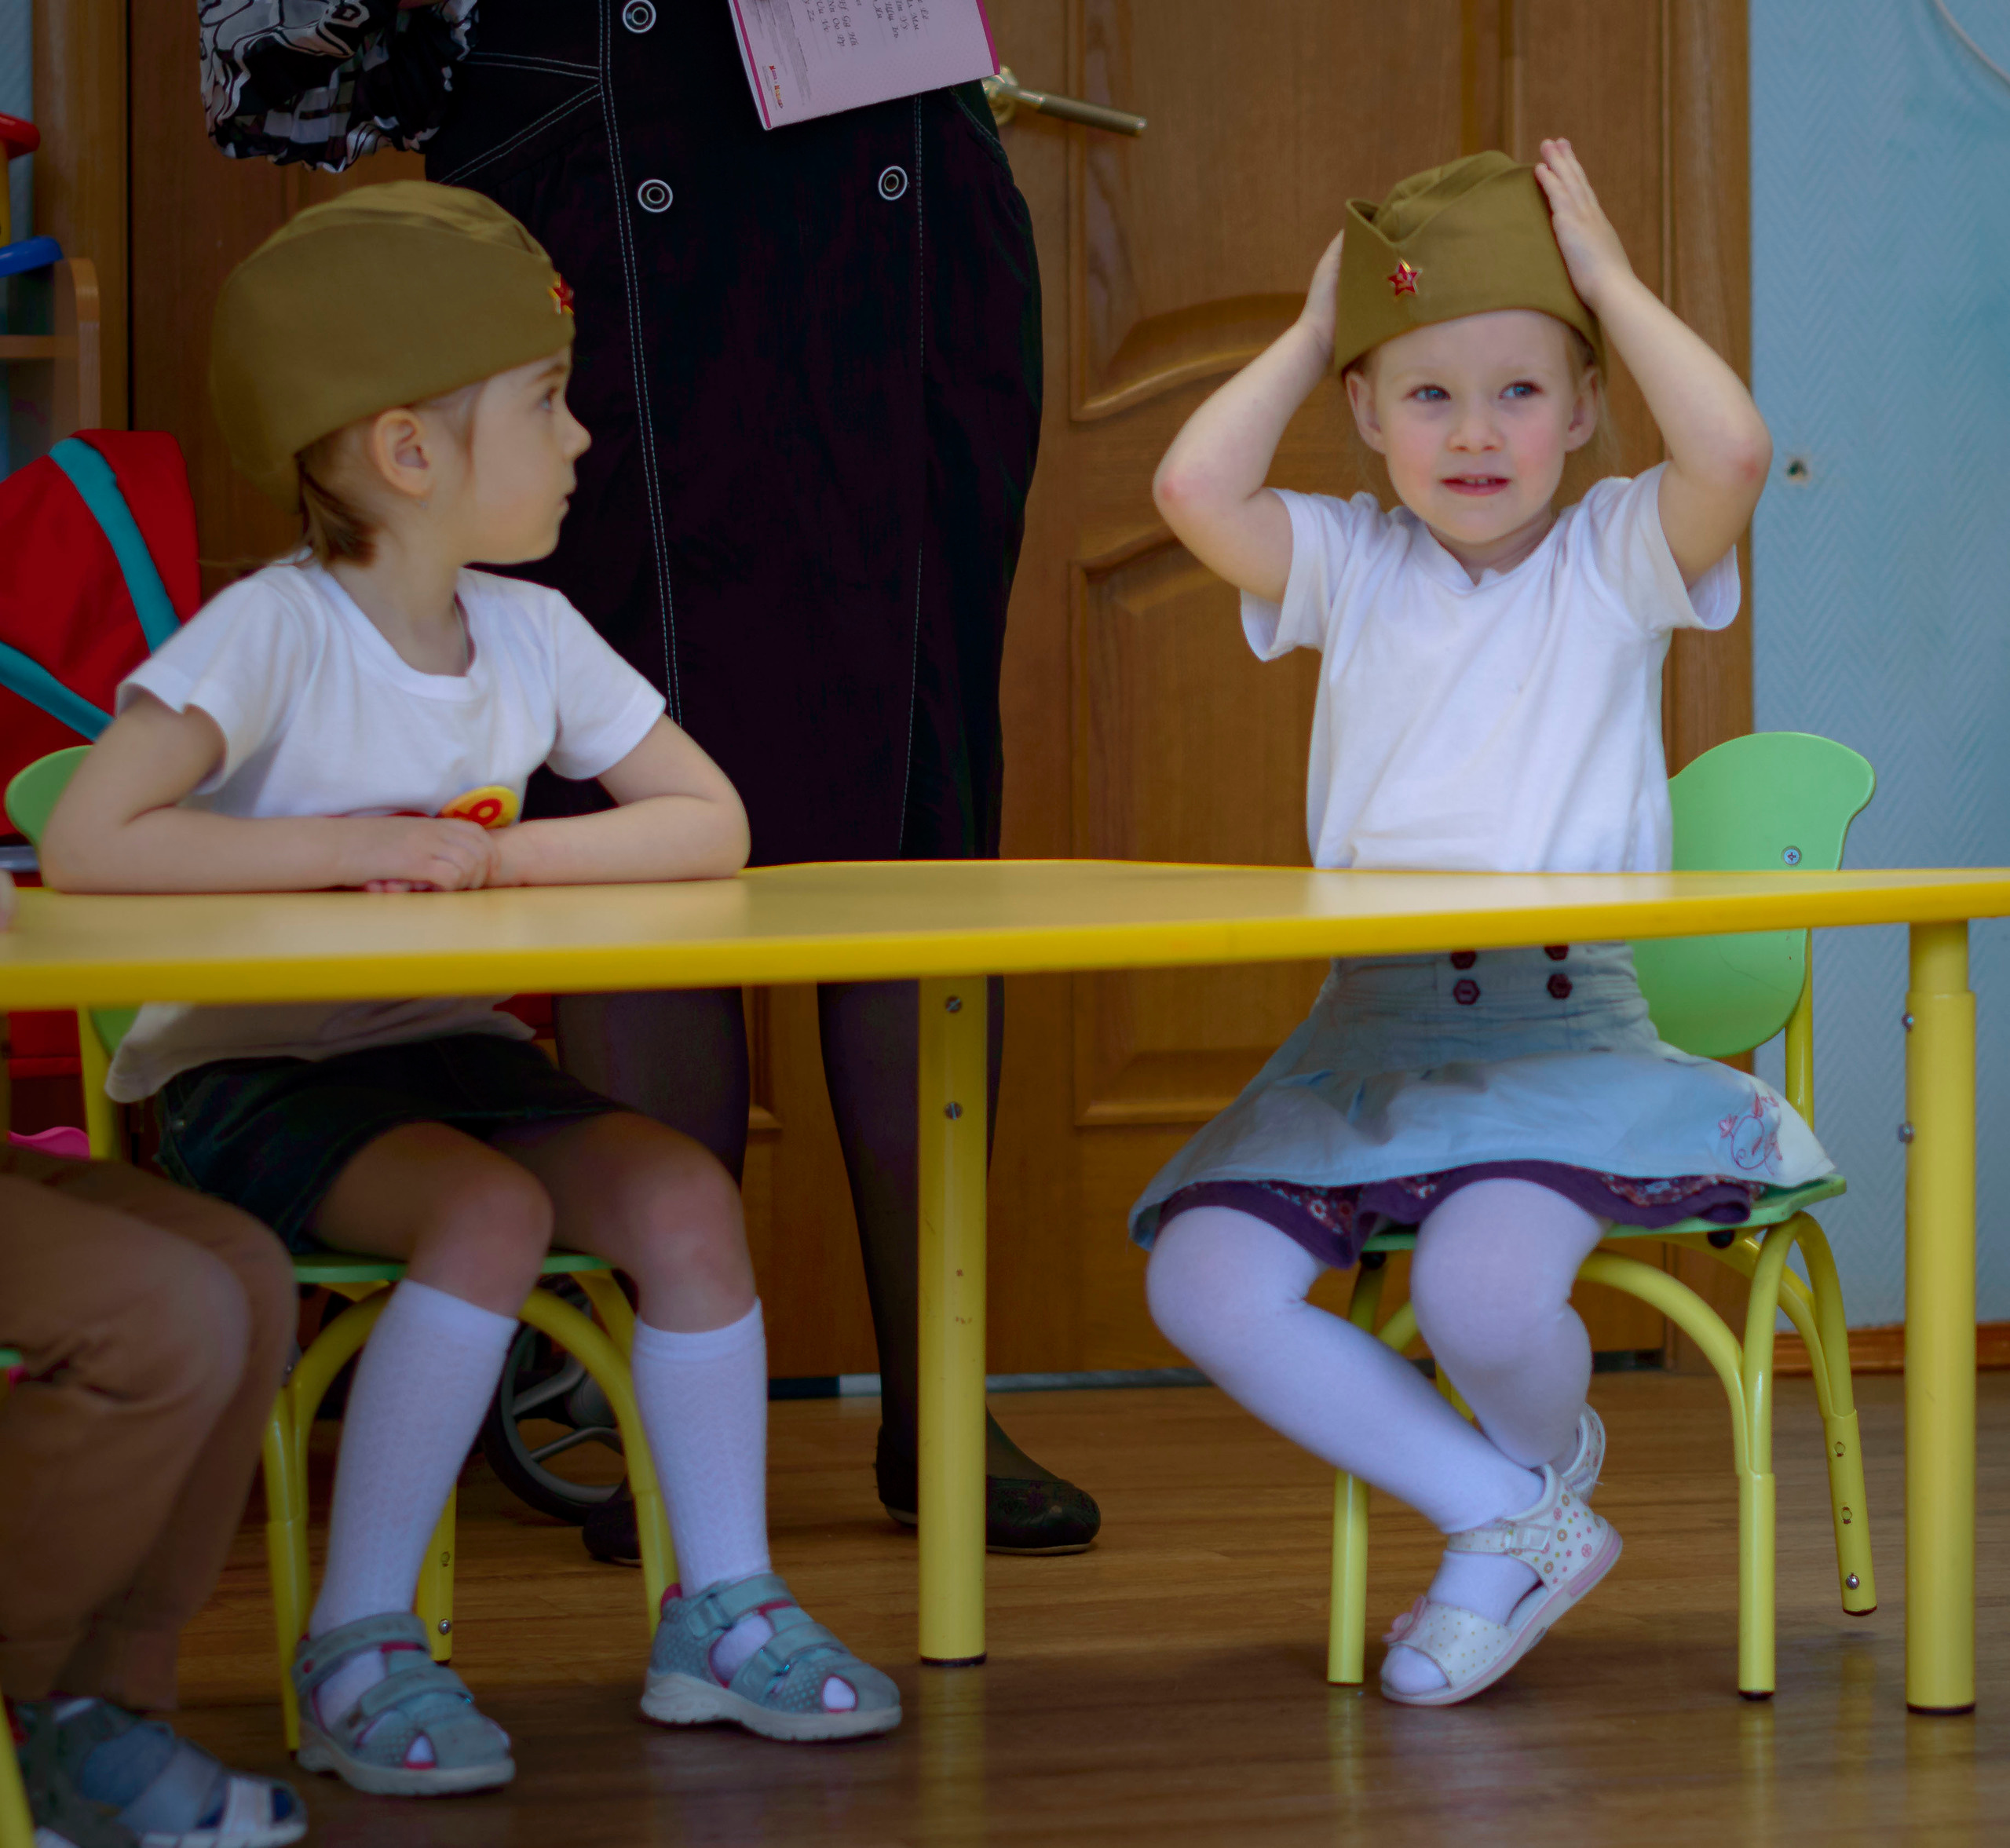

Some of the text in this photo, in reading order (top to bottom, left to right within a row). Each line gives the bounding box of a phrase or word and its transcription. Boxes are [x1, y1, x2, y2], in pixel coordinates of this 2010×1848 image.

[817, 1, 825, 14] Uu
[806, 9, 815, 22] Zz
[910, 13, 919, 31] Мм
[832, 17, 841, 30] Oo
[842, 15, 851, 27] Gg
[848, 31, 859, 46] Hh
[836, 34, 846, 47] Pp
